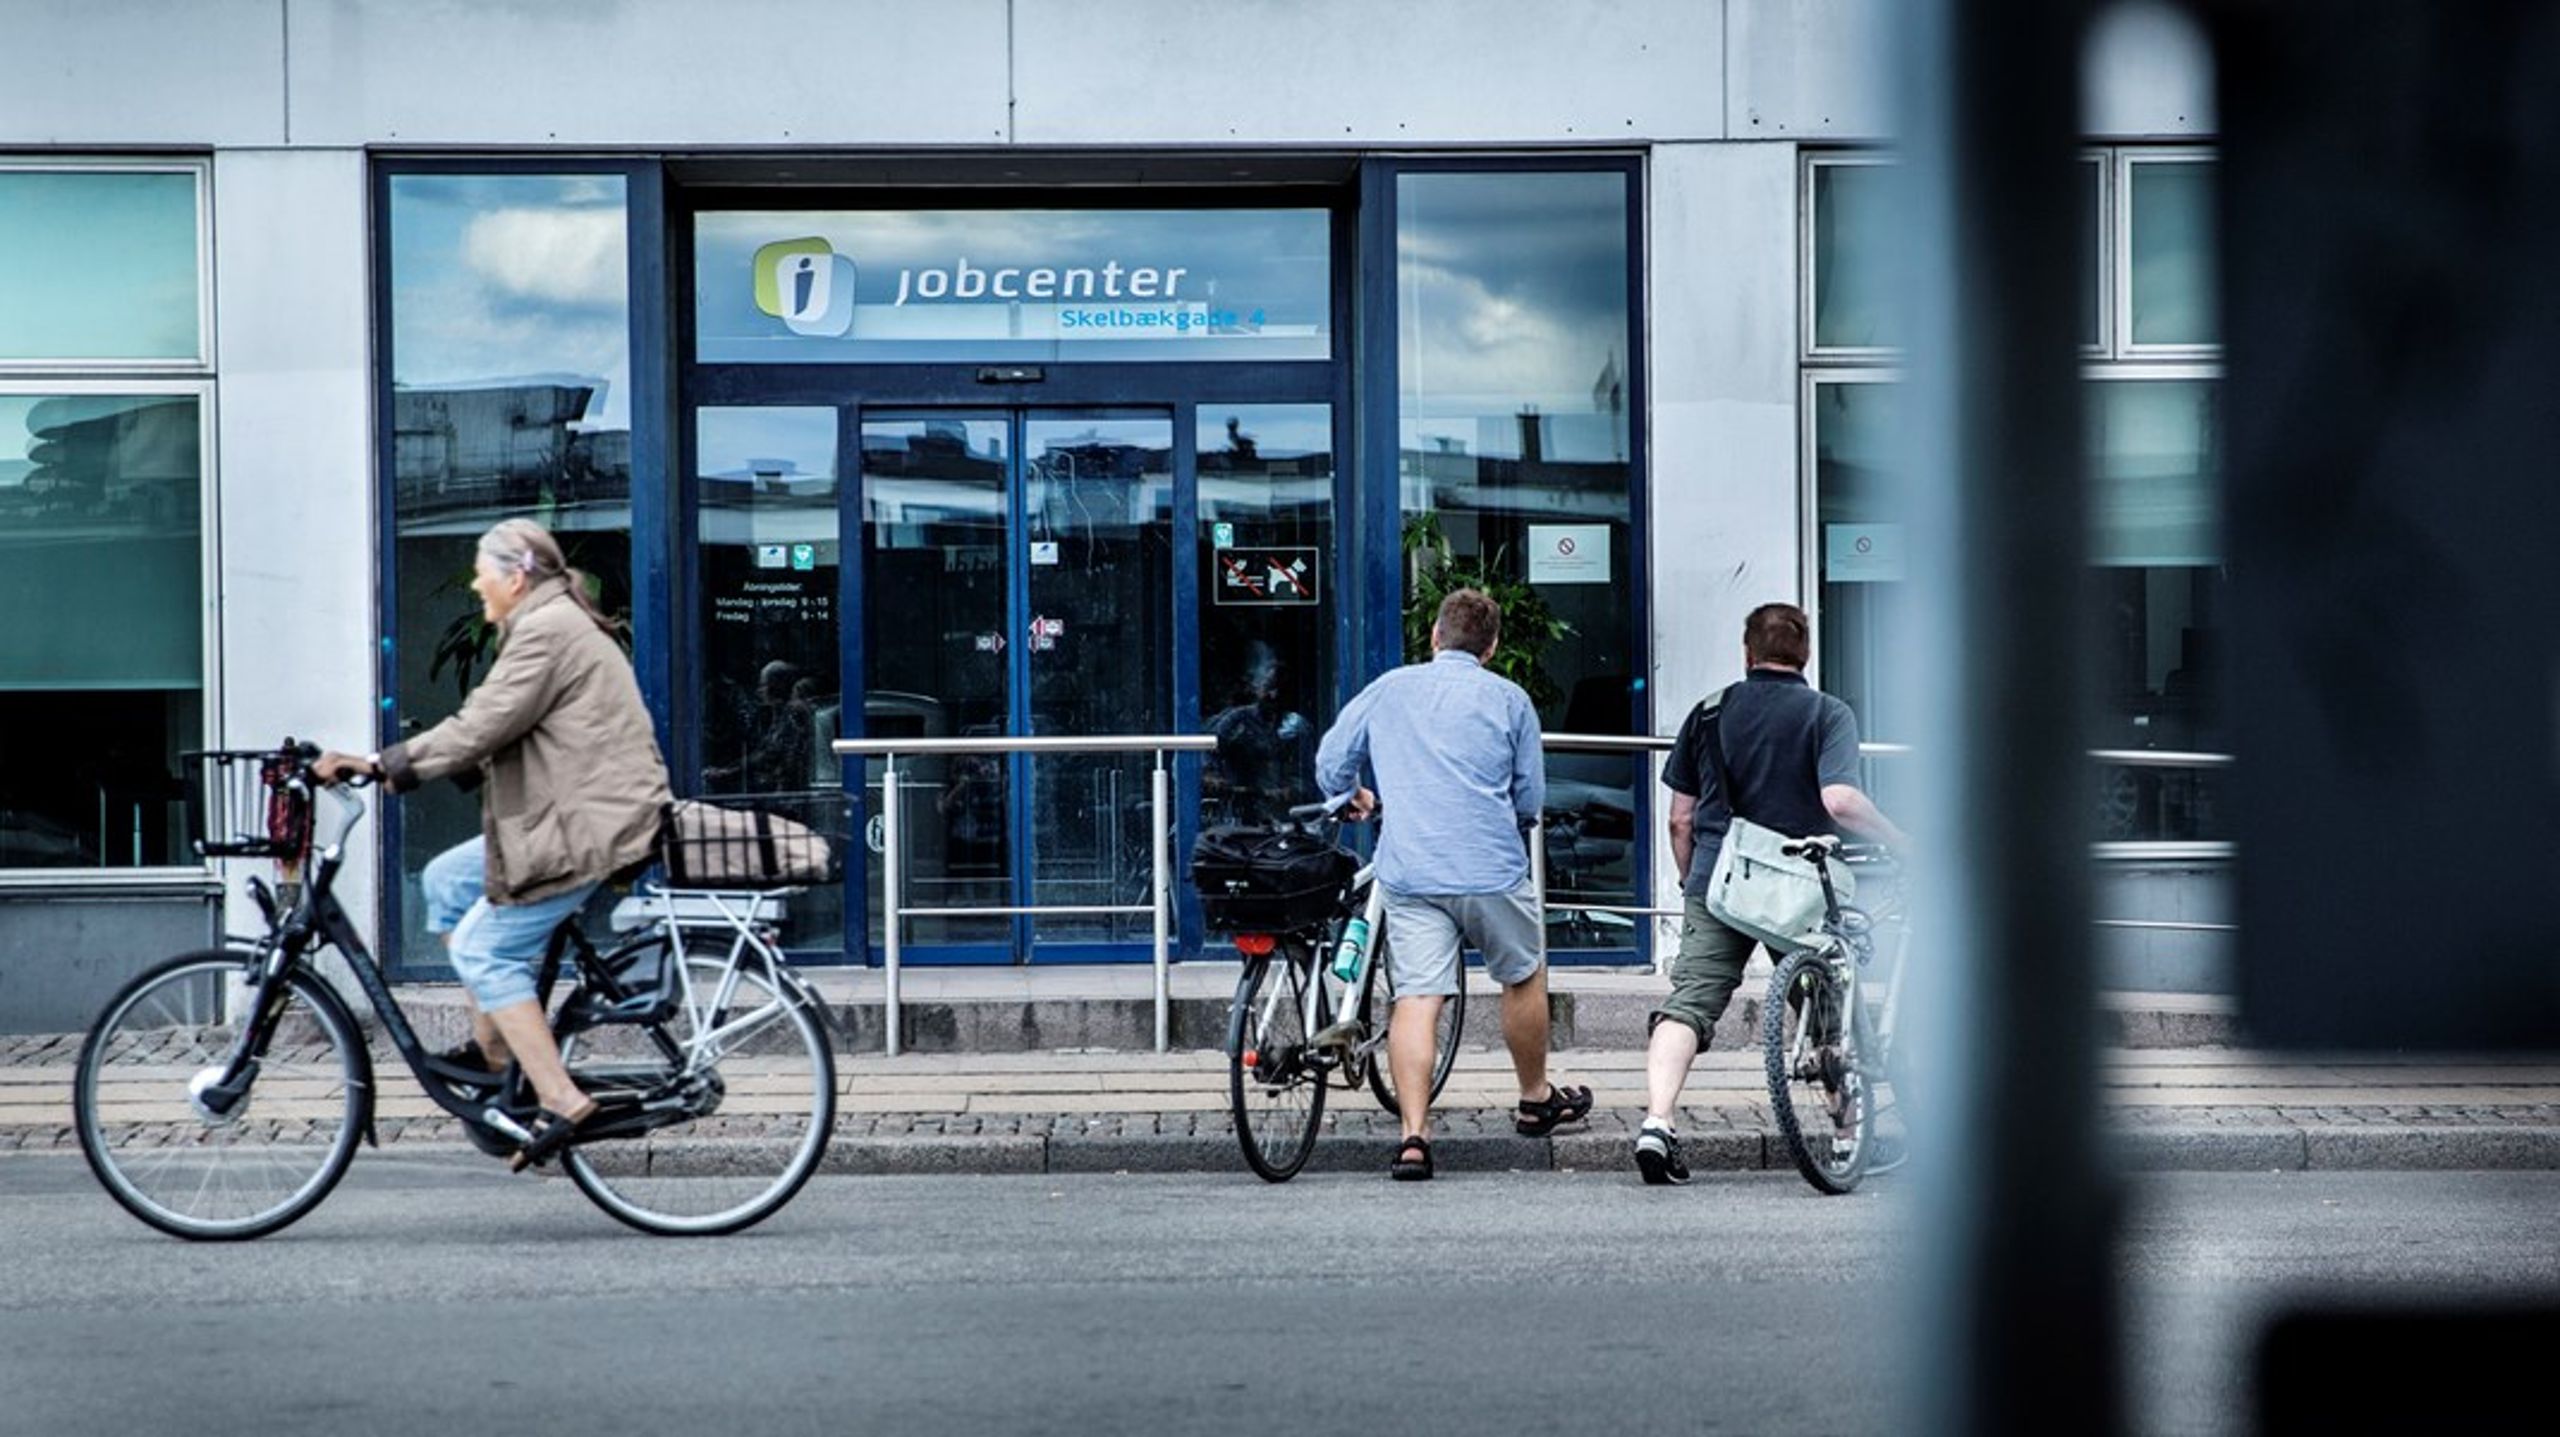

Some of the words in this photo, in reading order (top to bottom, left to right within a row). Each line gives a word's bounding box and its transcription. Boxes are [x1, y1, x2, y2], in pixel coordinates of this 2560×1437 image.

[894, 257, 1187, 307] jobcenter
[1061, 307, 1238, 331] Skelbækgade
[1249, 307, 1266, 326] 4
[715, 597, 754, 609] Mandag
[761, 597, 798, 609] torsdag
[715, 611, 750, 623] Fredag
